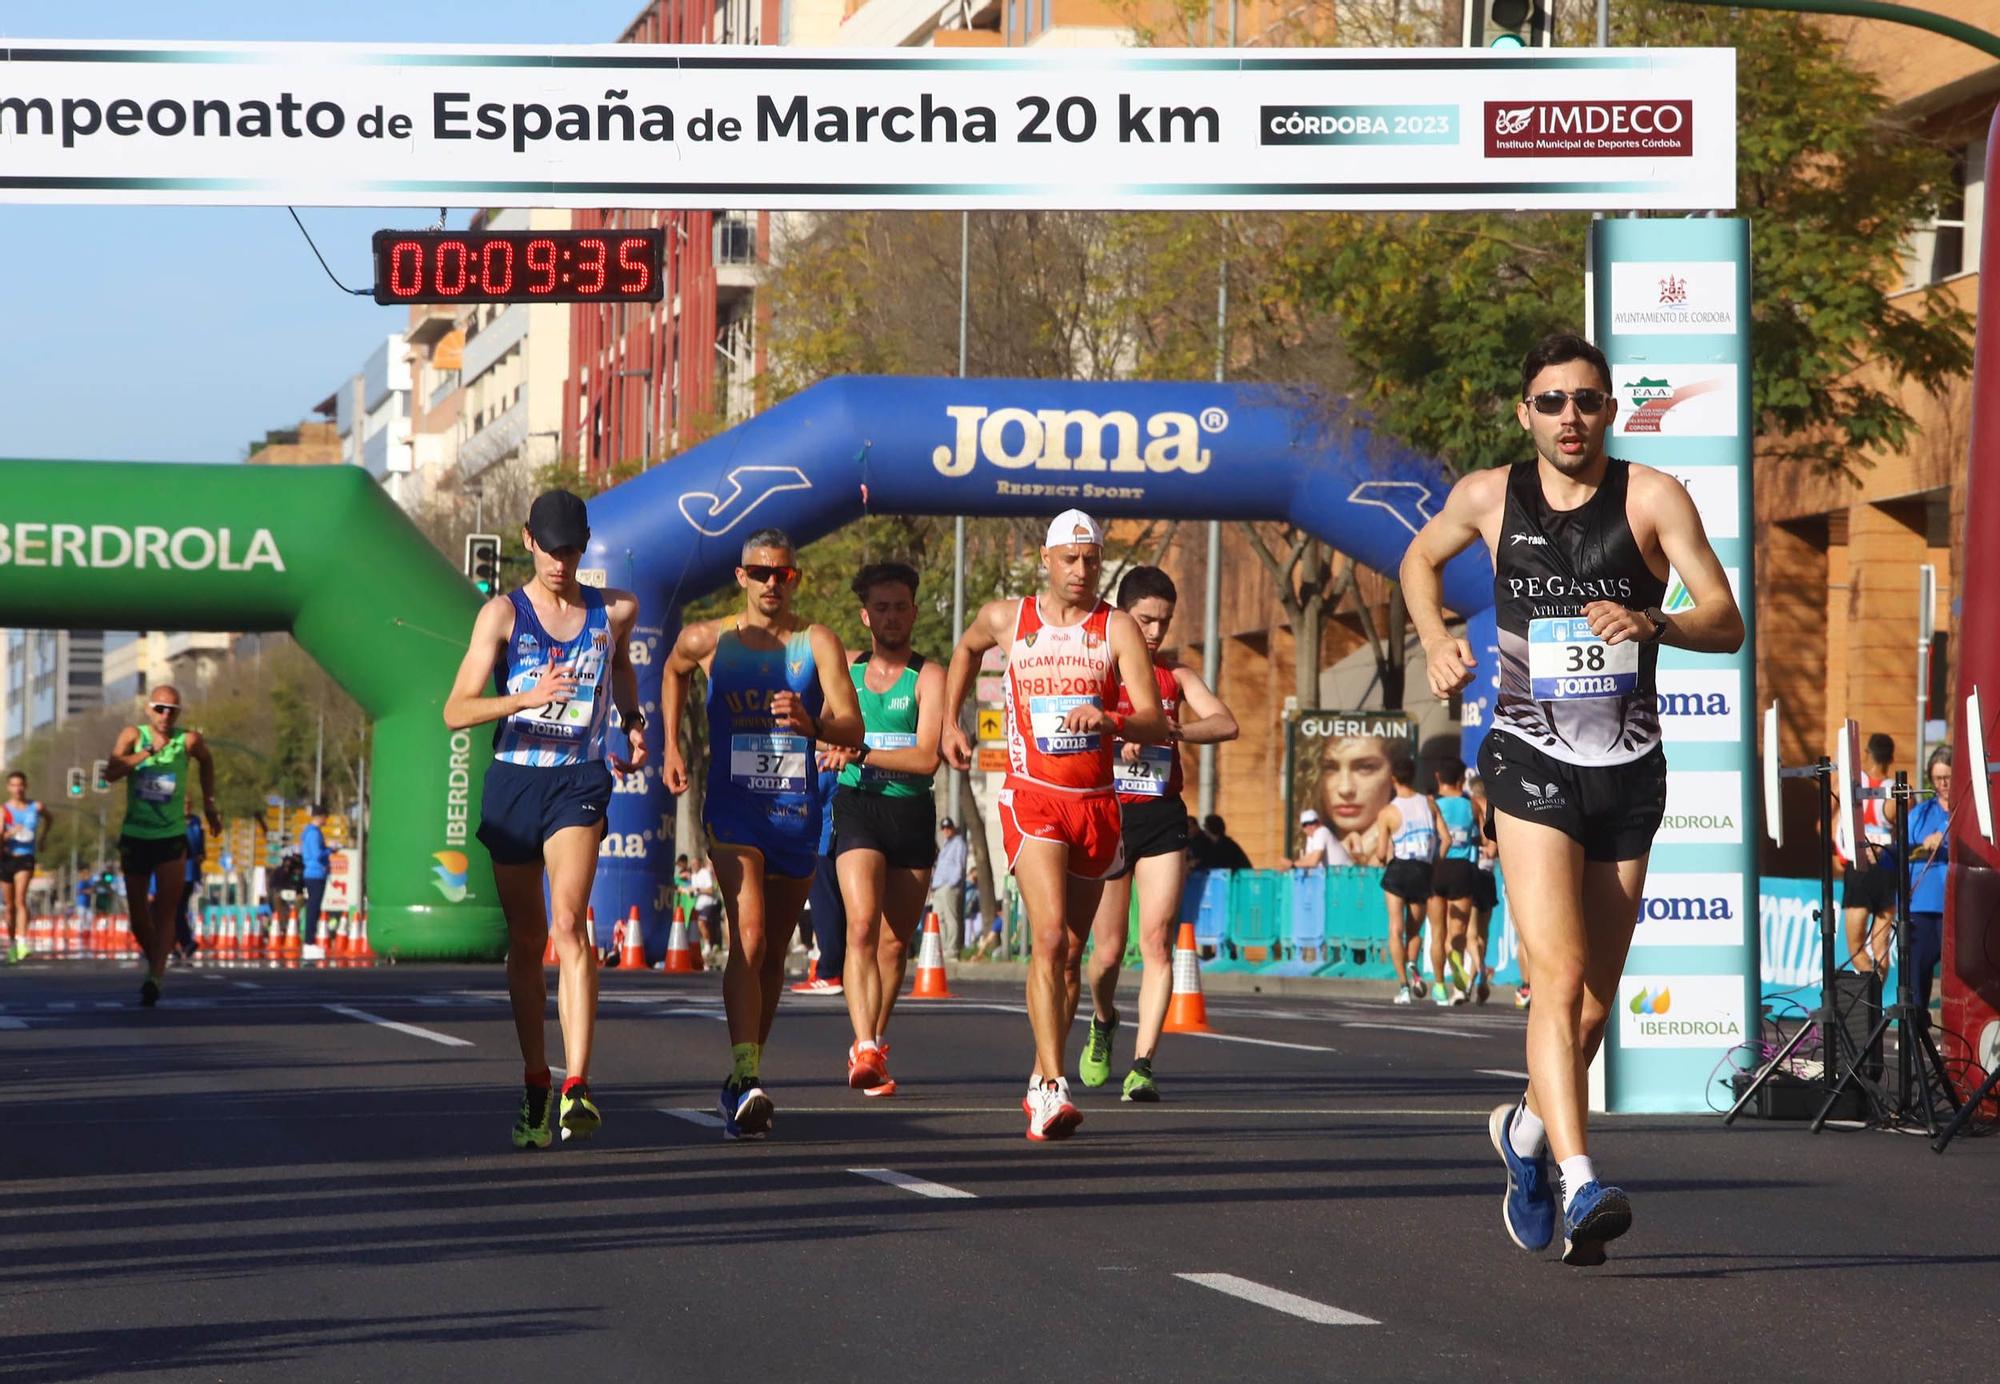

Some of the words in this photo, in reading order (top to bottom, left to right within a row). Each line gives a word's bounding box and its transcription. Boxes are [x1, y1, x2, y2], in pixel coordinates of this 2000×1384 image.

[0, 93, 345, 148] mpeonato
[358, 105, 413, 139] de
[434, 89, 674, 153] España
[687, 108, 742, 142] de
[758, 93, 997, 143] Marcha
[1016, 95, 1097, 143] 20
[1119, 93, 1220, 143] km
[1270, 111, 1389, 135] CÓRDOBA
[1394, 116, 1450, 134] 2023
[1538, 104, 1683, 134] IMDECO
[1496, 139, 1534, 149] Instituto
[1536, 138, 1581, 150] Municipal
[1583, 138, 1596, 148] de
[1597, 138, 1640, 150] Deportes
[1642, 137, 1682, 148] Córdoba
[1615, 312, 1677, 323] AYUNTAMIENTO
[1679, 312, 1691, 323] DE
[1532, 603, 1583, 617] ATHLETI
[1019, 655, 1055, 670] UCAM
[1565, 644, 1606, 672] 38
[539, 701, 568, 721] 27
[724, 687, 777, 714] UCA
[1657, 692, 1730, 716] ma
[1301, 718, 1408, 739] GUERLAIN
[755, 753, 785, 774] 37
[1128, 761, 1151, 778] 42
[446, 727, 472, 846] IBERDRO
[1659, 815, 1734, 829] RDROLA
[1640, 1021, 1740, 1036] IBERDROLA
